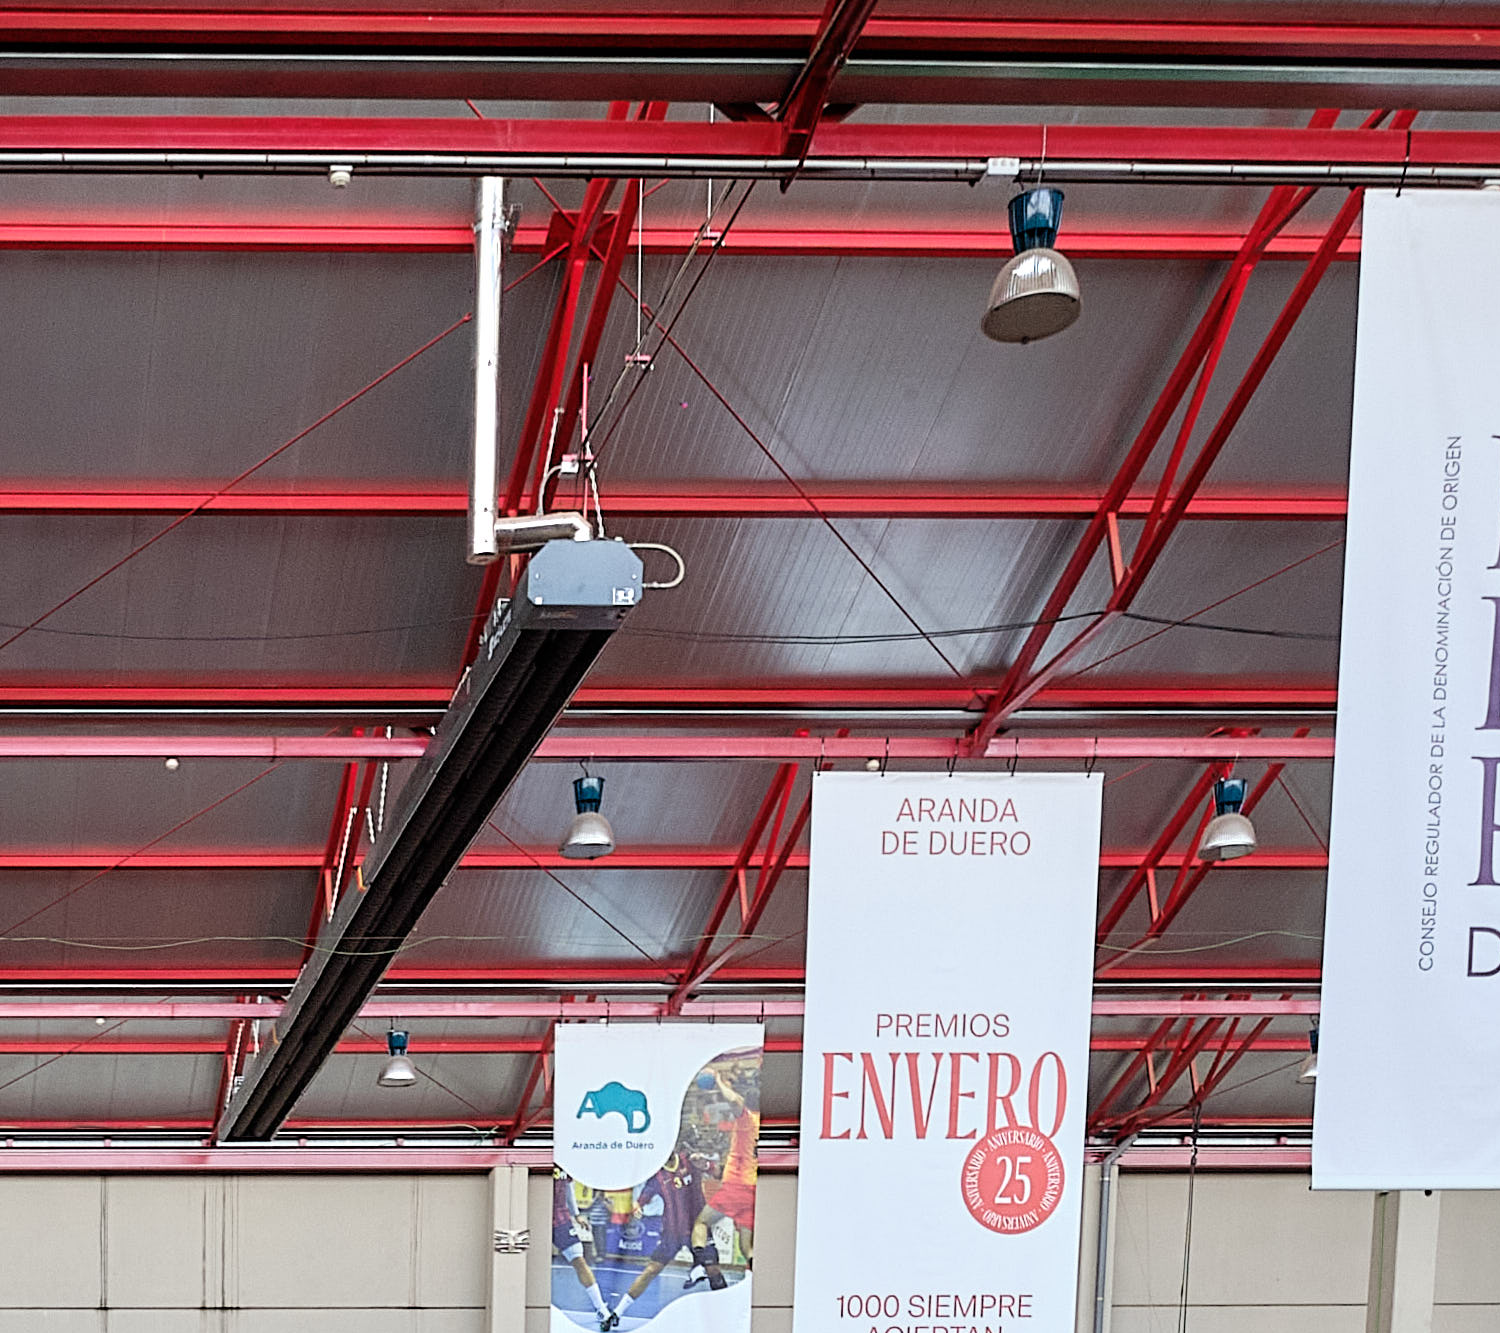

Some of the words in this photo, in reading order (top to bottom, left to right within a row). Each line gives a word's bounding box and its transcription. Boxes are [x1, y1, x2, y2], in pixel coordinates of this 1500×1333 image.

[1442, 436, 1462, 511] ORIGEN
[1440, 516, 1456, 541] DE
[1433, 547, 1454, 701] DENOMINACIÓN
[1432, 706, 1447, 728] LA
[1430, 733, 1446, 758] DE
[895, 798, 1019, 823] ARANDA
[1424, 763, 1444, 877] REGULADOR
[881, 831, 920, 856] DE
[928, 831, 1032, 856] DUERO
[1419, 882, 1439, 972] CONSEJO
[875, 1013, 1011, 1038] PREMIOS
[818, 1051, 1068, 1141] ENVERO
[572, 1141, 608, 1151] Aranda
[610, 1140, 623, 1150] de
[625, 1140, 655, 1151] Duero
[986, 1129, 1045, 1152] ANIVERSARIO
[964, 1148, 985, 1211] ANIVERSARIO
[993, 1155, 1033, 1206] 25
[1042, 1150, 1061, 1212] ANIVERSARIO
[981, 1208, 1040, 1231] ANIVERSARIO
[836, 1294, 900, 1319] 1000
[907, 1294, 1034, 1319] SIEMPRE
